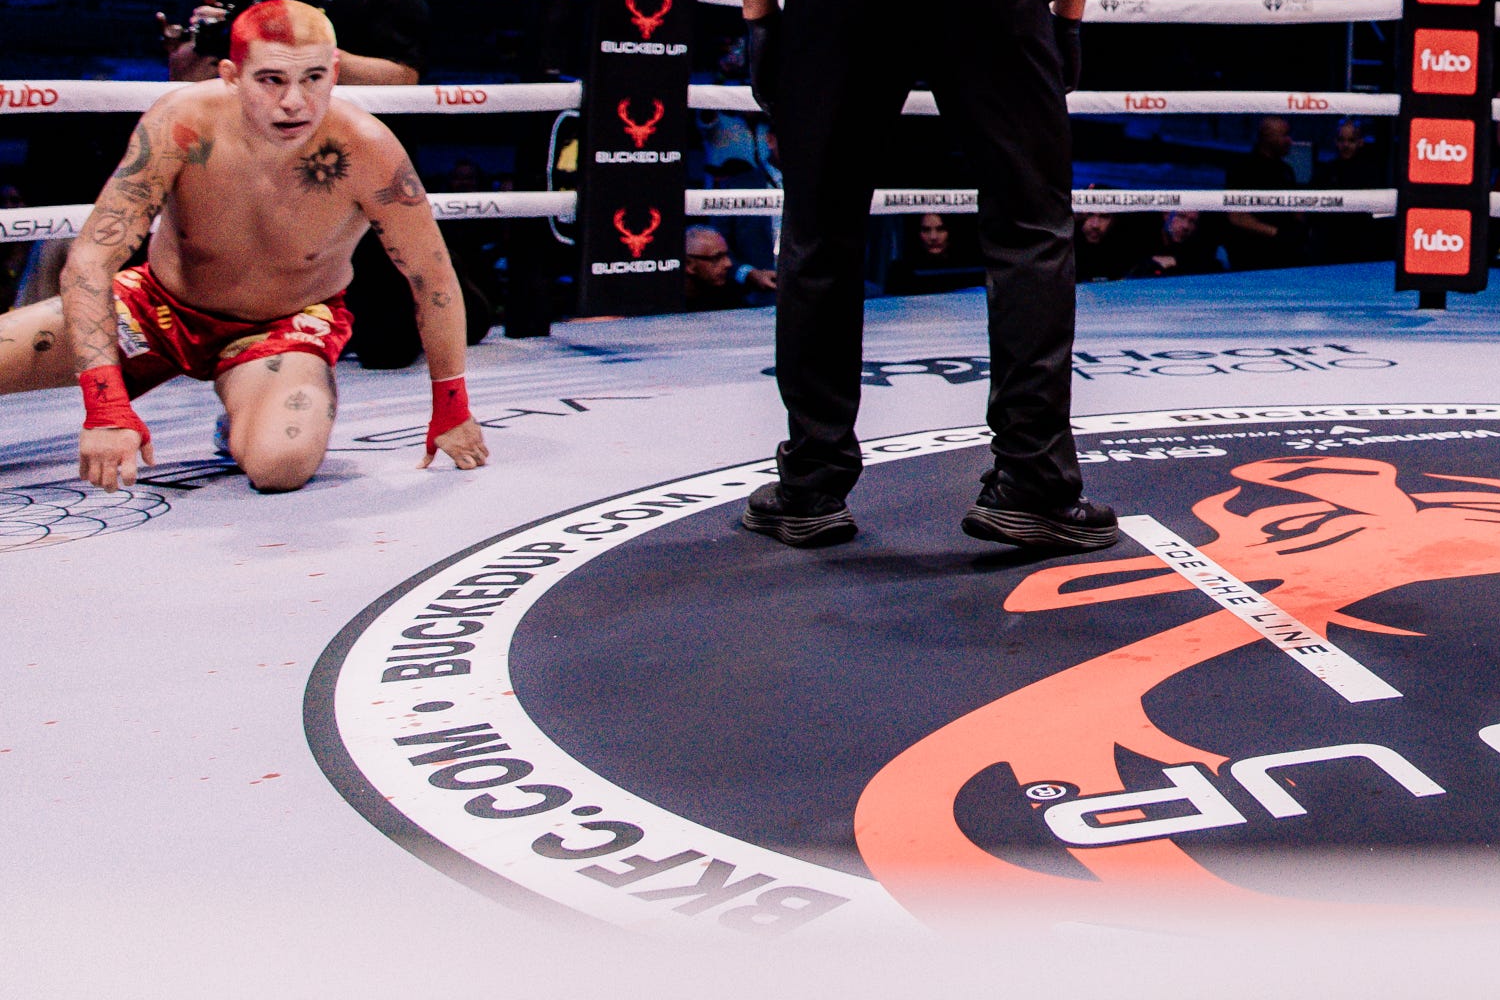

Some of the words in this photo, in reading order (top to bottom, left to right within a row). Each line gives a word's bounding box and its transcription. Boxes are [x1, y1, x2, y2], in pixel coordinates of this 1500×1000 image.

[601, 40, 665, 56] BUCKED
[666, 43, 688, 56] UP
[1420, 48, 1471, 72] fubo
[434, 86, 488, 105] fubo
[1124, 93, 1167, 110] fubo
[1287, 94, 1329, 111] fubo
[595, 151, 659, 163] BUCKED
[659, 151, 681, 163] UP
[1416, 137, 1467, 162] fubo
[702, 195, 781, 211] BAREKNUCKLE
[884, 193, 978, 207] BAREKNUCKLESH
[1412, 227, 1464, 252] fubo
[591, 261, 656, 275] BUCKED
[658, 259, 680, 271] UP
[1074, 343, 1367, 363] Heart
[1073, 357, 1398, 380] Radio
[381, 492, 717, 683] BUCKEDUP.COM
[1155, 541, 1209, 569] TOE
[1200, 576, 1258, 605] THE
[1251, 613, 1329, 656] LINE
[1043, 743, 1446, 845] UP
[393, 722, 852, 938] BKFC.COM
